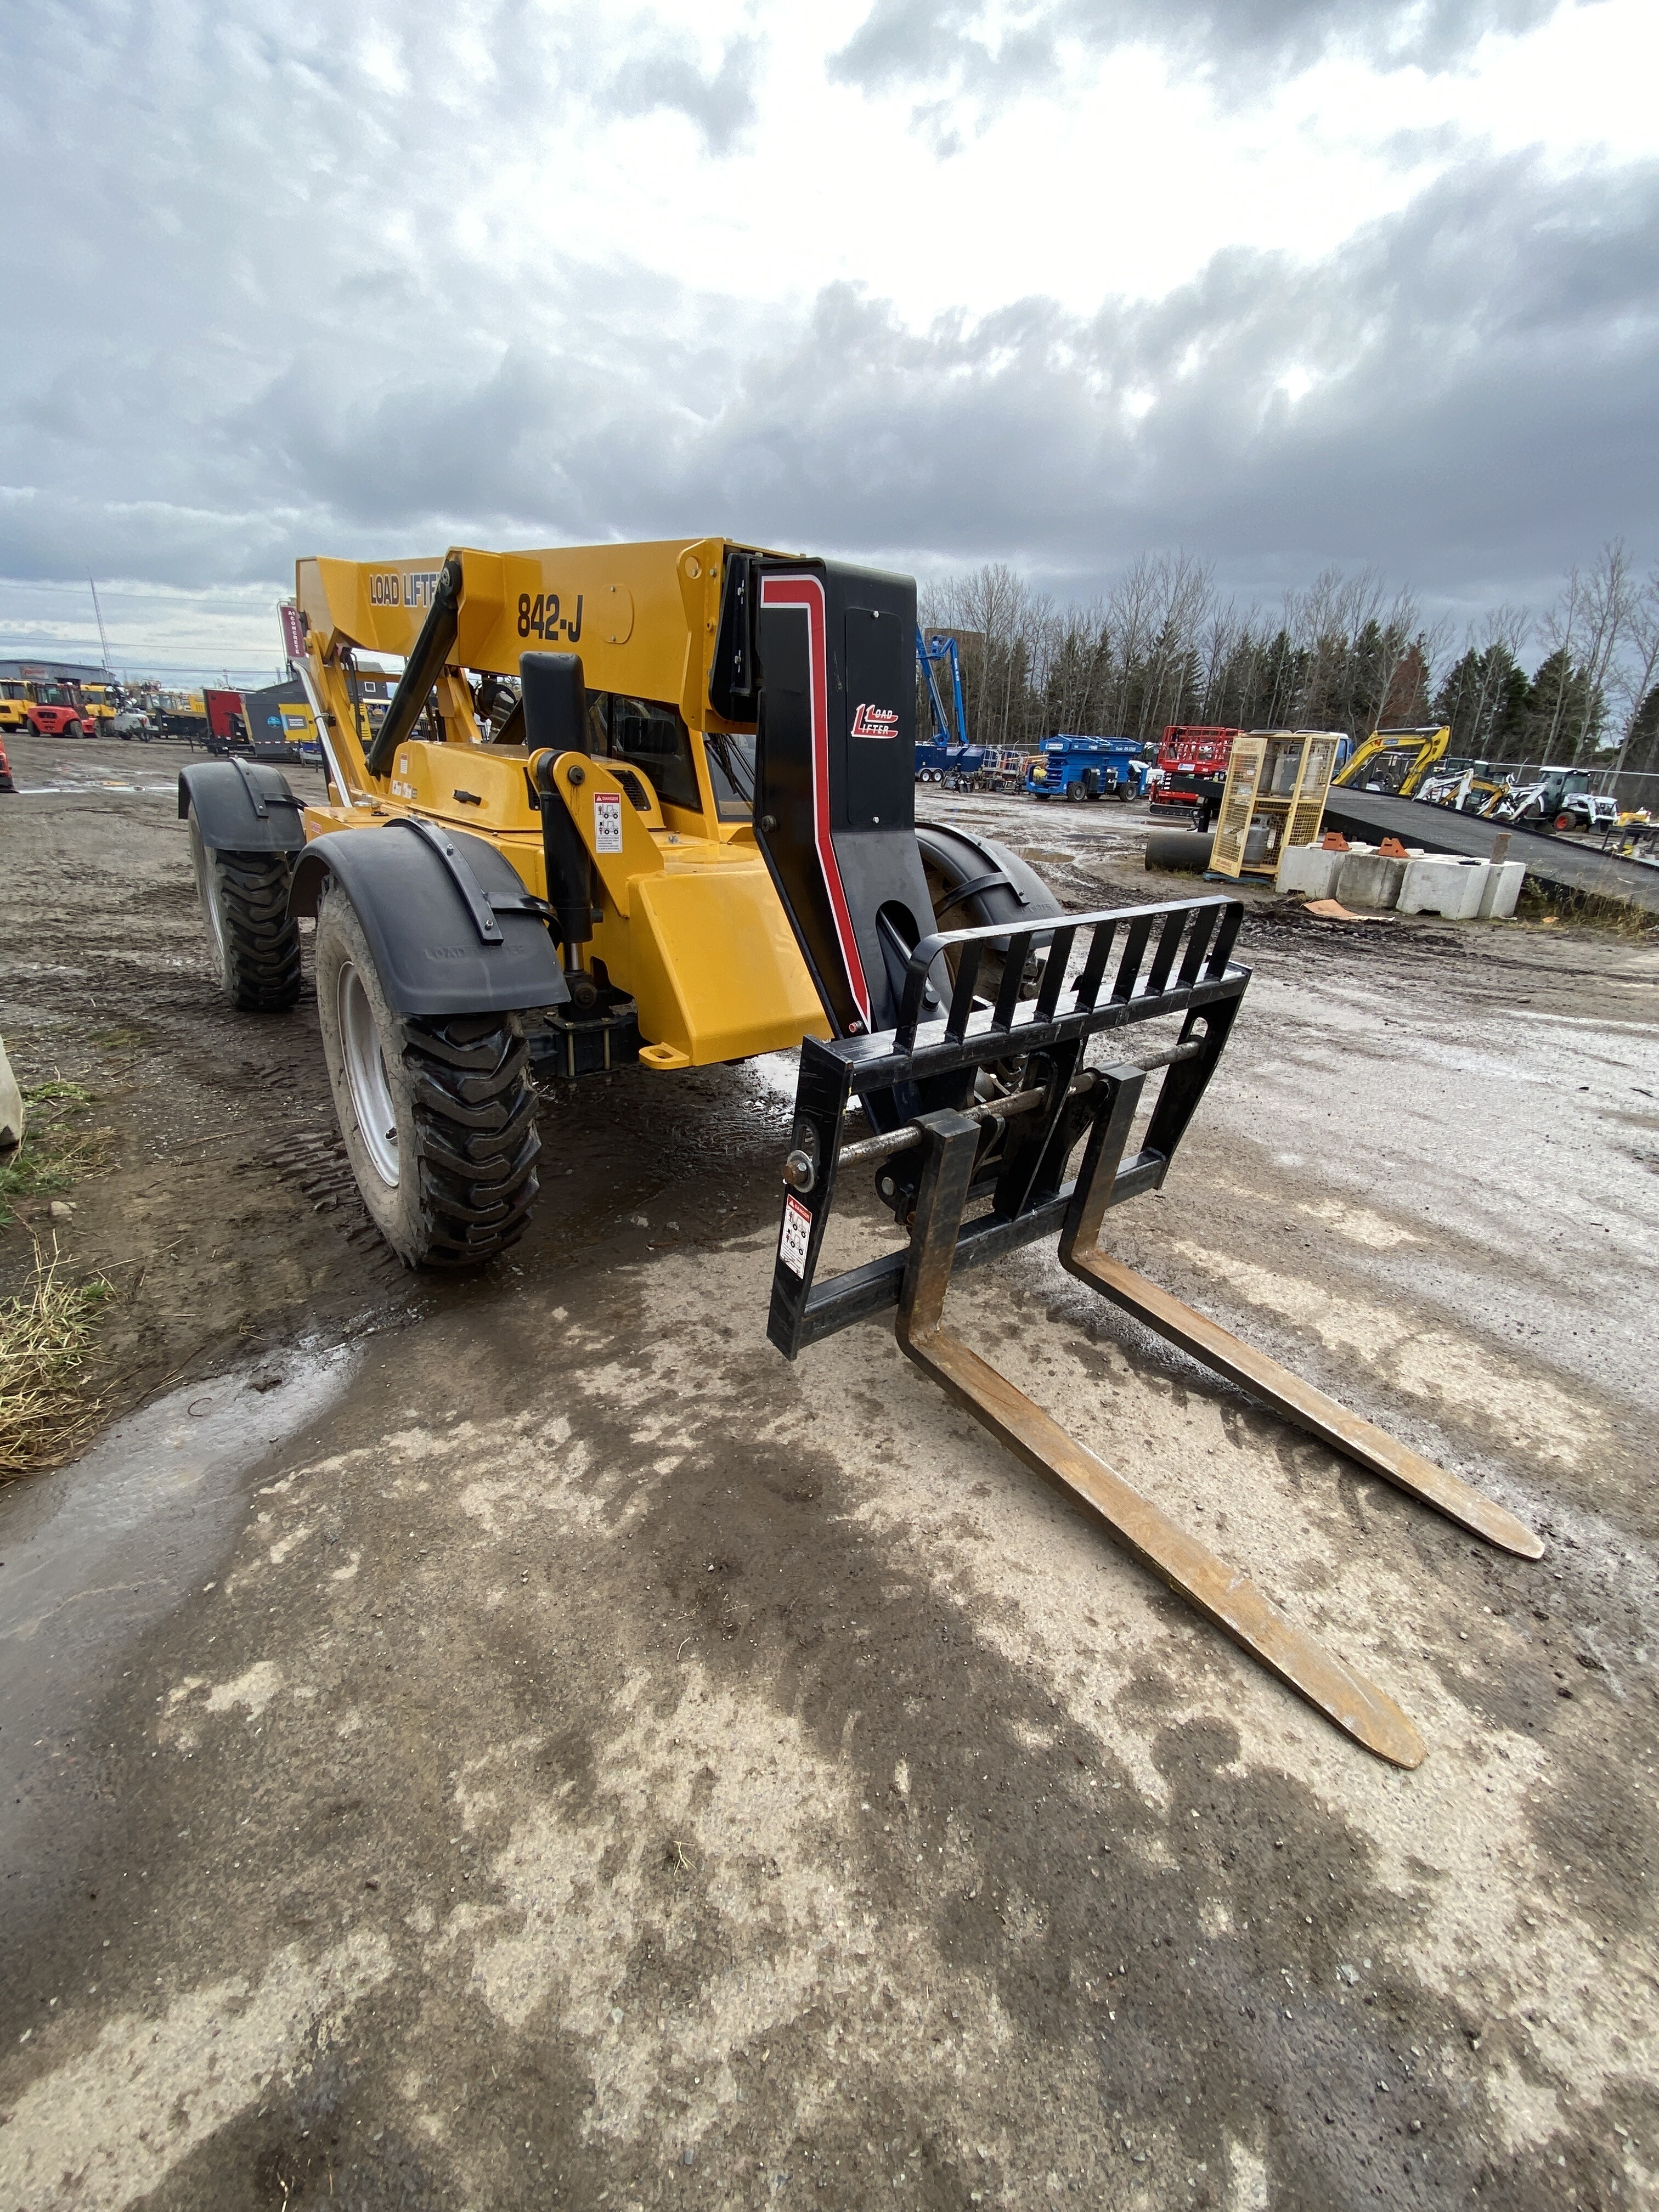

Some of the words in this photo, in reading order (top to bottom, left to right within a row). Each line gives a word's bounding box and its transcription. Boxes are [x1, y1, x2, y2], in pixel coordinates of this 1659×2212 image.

[369, 573, 400, 607] LOAD
[403, 572, 441, 608] LIFTE
[290, 616, 300, 654] CONCRETE
[517, 594, 583, 642] 842-J
[851, 703, 899, 739] LIFTER
[864, 704, 899, 724] LOAD
[794, 1203, 809, 1219] DANGER
